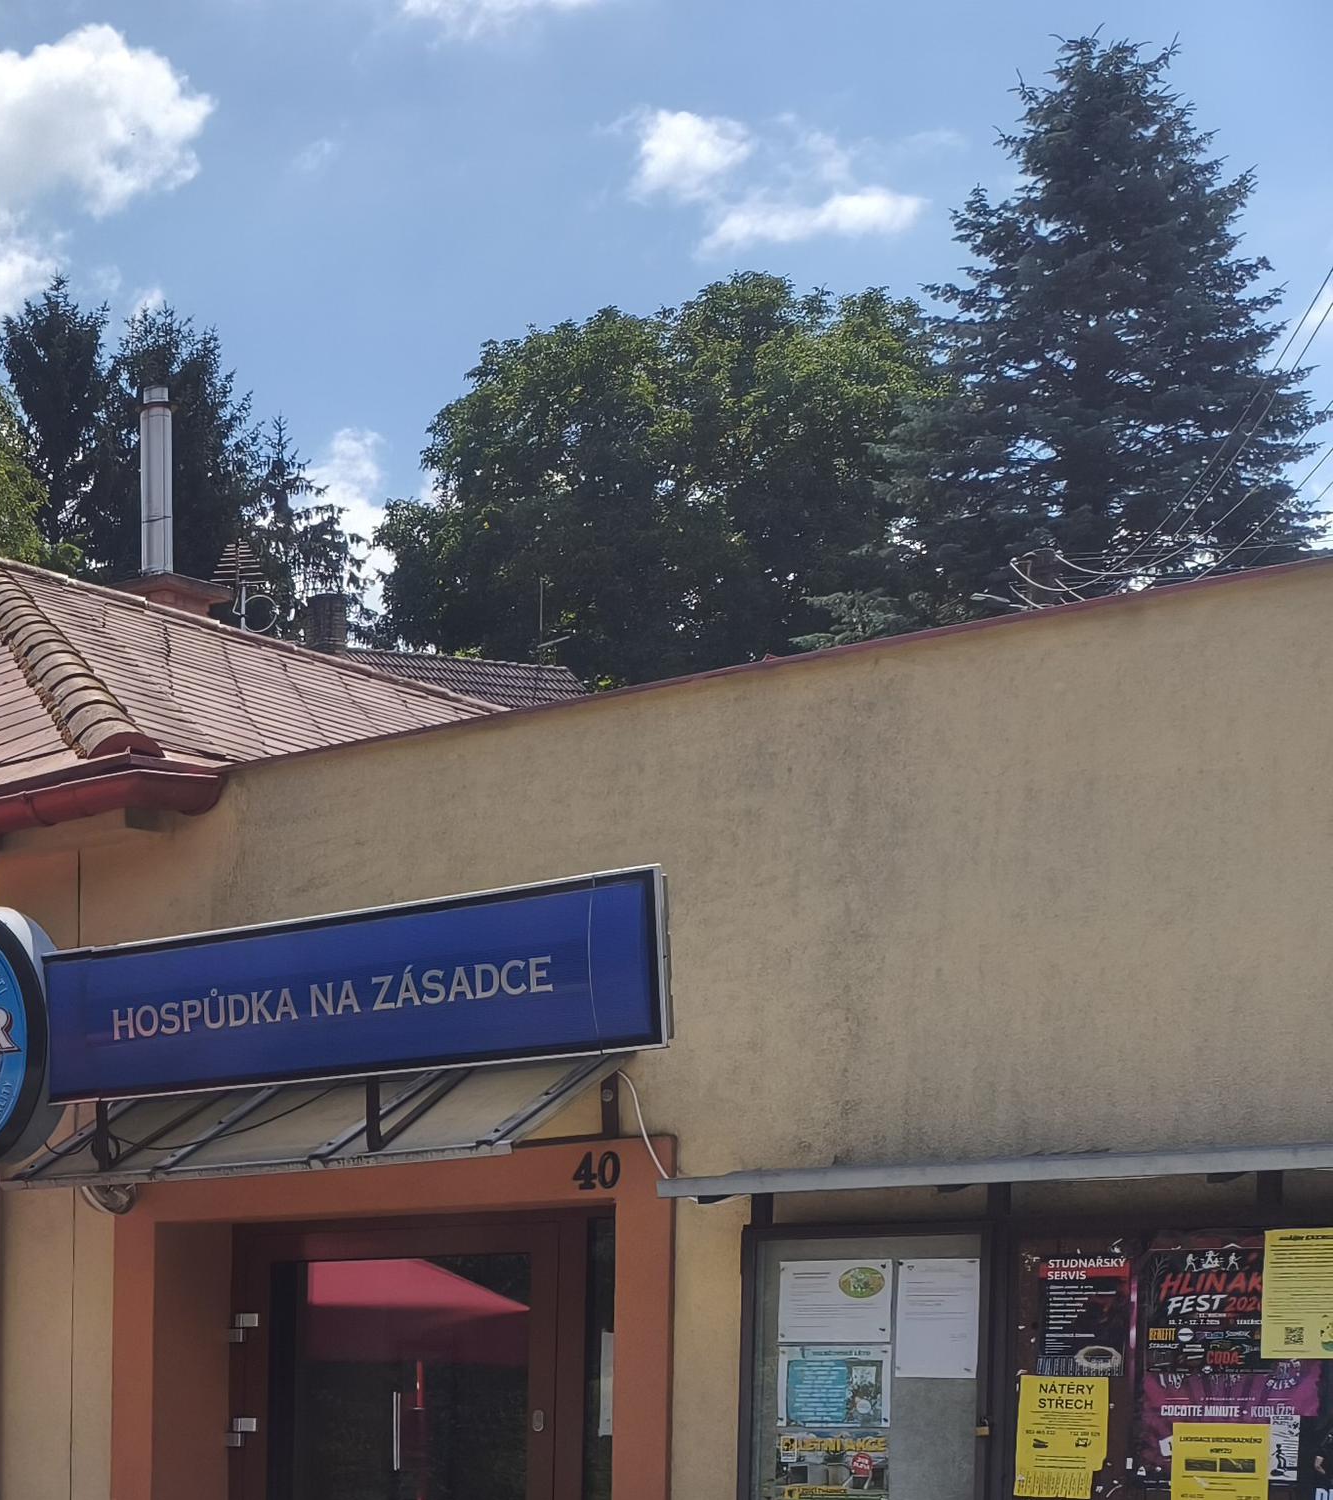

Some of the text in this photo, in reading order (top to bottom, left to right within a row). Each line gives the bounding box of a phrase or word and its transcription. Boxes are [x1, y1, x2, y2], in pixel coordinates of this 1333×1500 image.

[112, 954, 554, 1041] HOSPŮDKA NA ZÁSADCE
[573, 1151, 621, 1191] 40
[1047, 1256, 1127, 1268] STUDNAŘSKÝ
[1047, 1270, 1087, 1280] SERVIS
[1167, 1294, 1261, 1316] FEST 202
[1039, 1381, 1094, 1395] NÁTĚRY
[1038, 1396, 1093, 1409] STŘECH
[1160, 1405, 1202, 1417] COCOTTE
[1204, 1405, 1240, 1417] MINUTE
